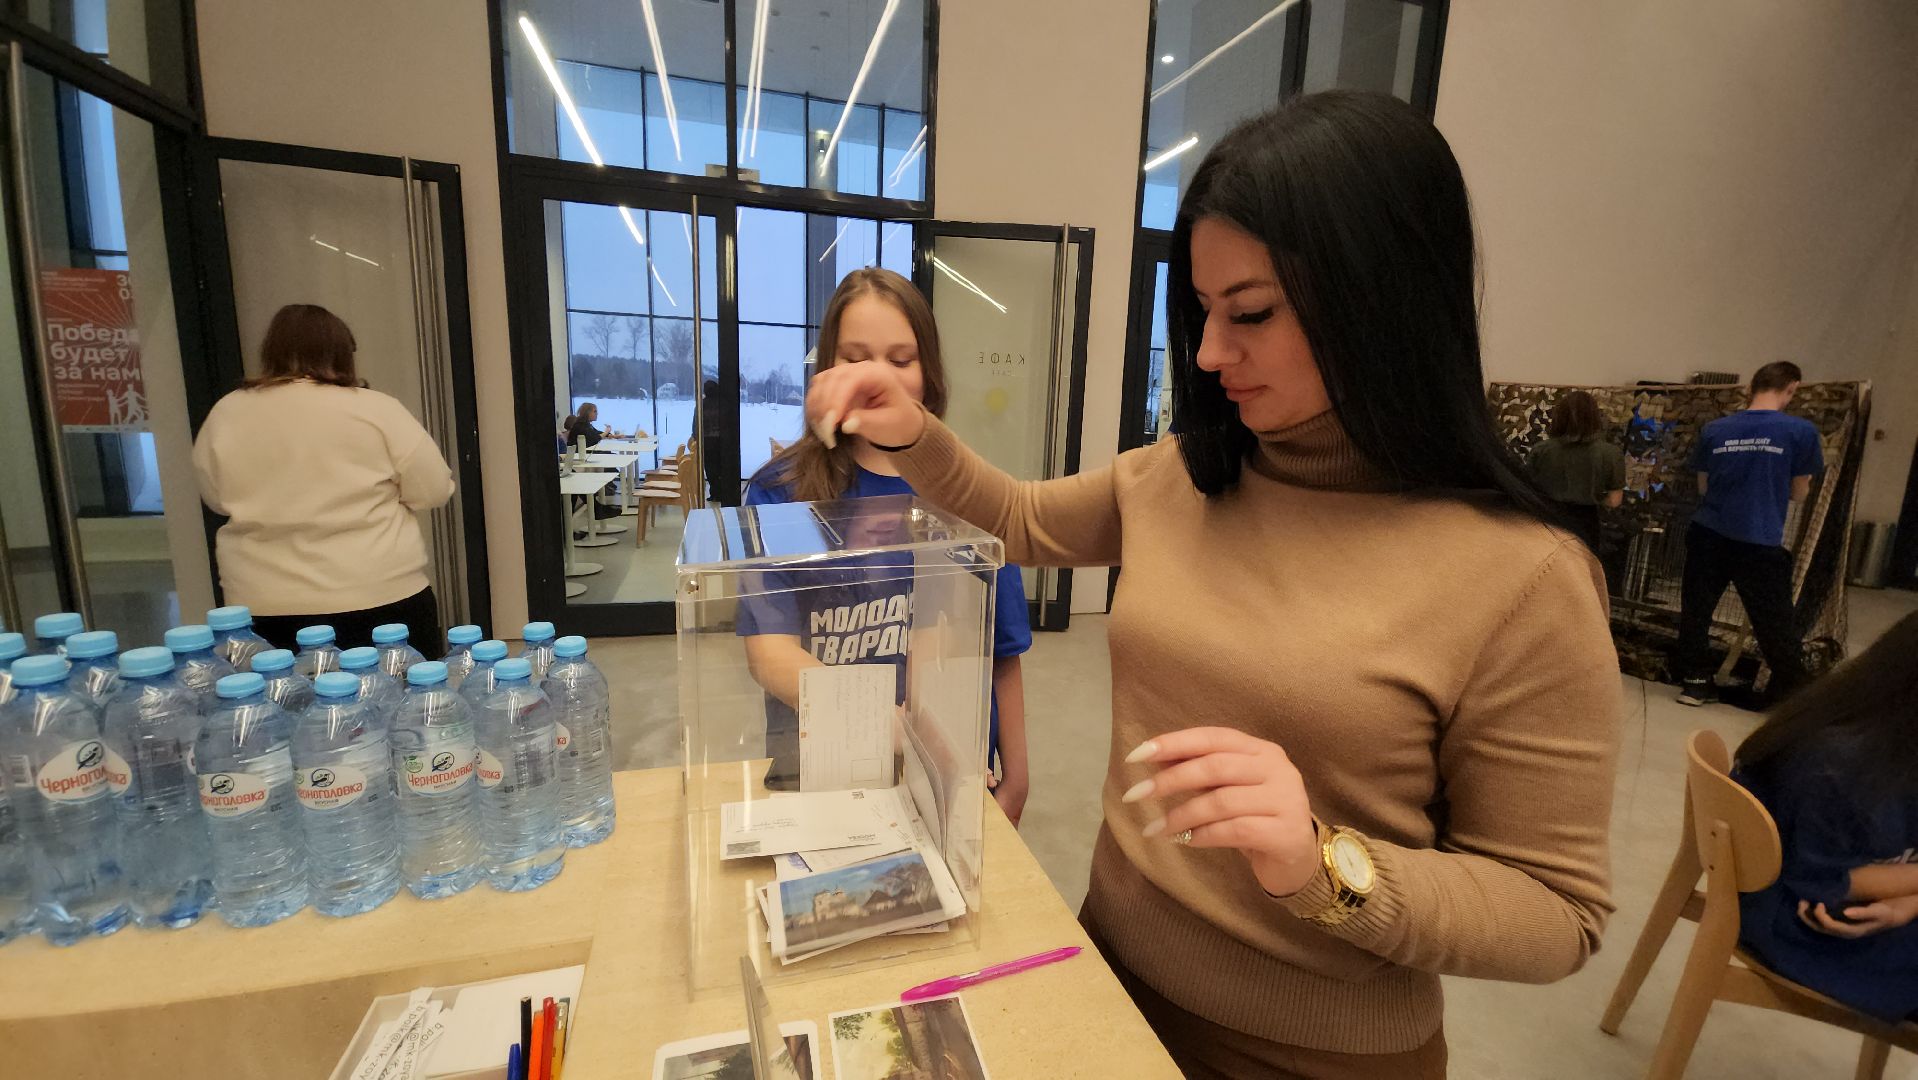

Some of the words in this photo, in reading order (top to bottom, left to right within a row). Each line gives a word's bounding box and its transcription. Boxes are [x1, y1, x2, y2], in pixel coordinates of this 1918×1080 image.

[50, 342, 129, 366] будет
[54, 366, 83, 380] за
[810, 594, 908, 634] МОЛОД
